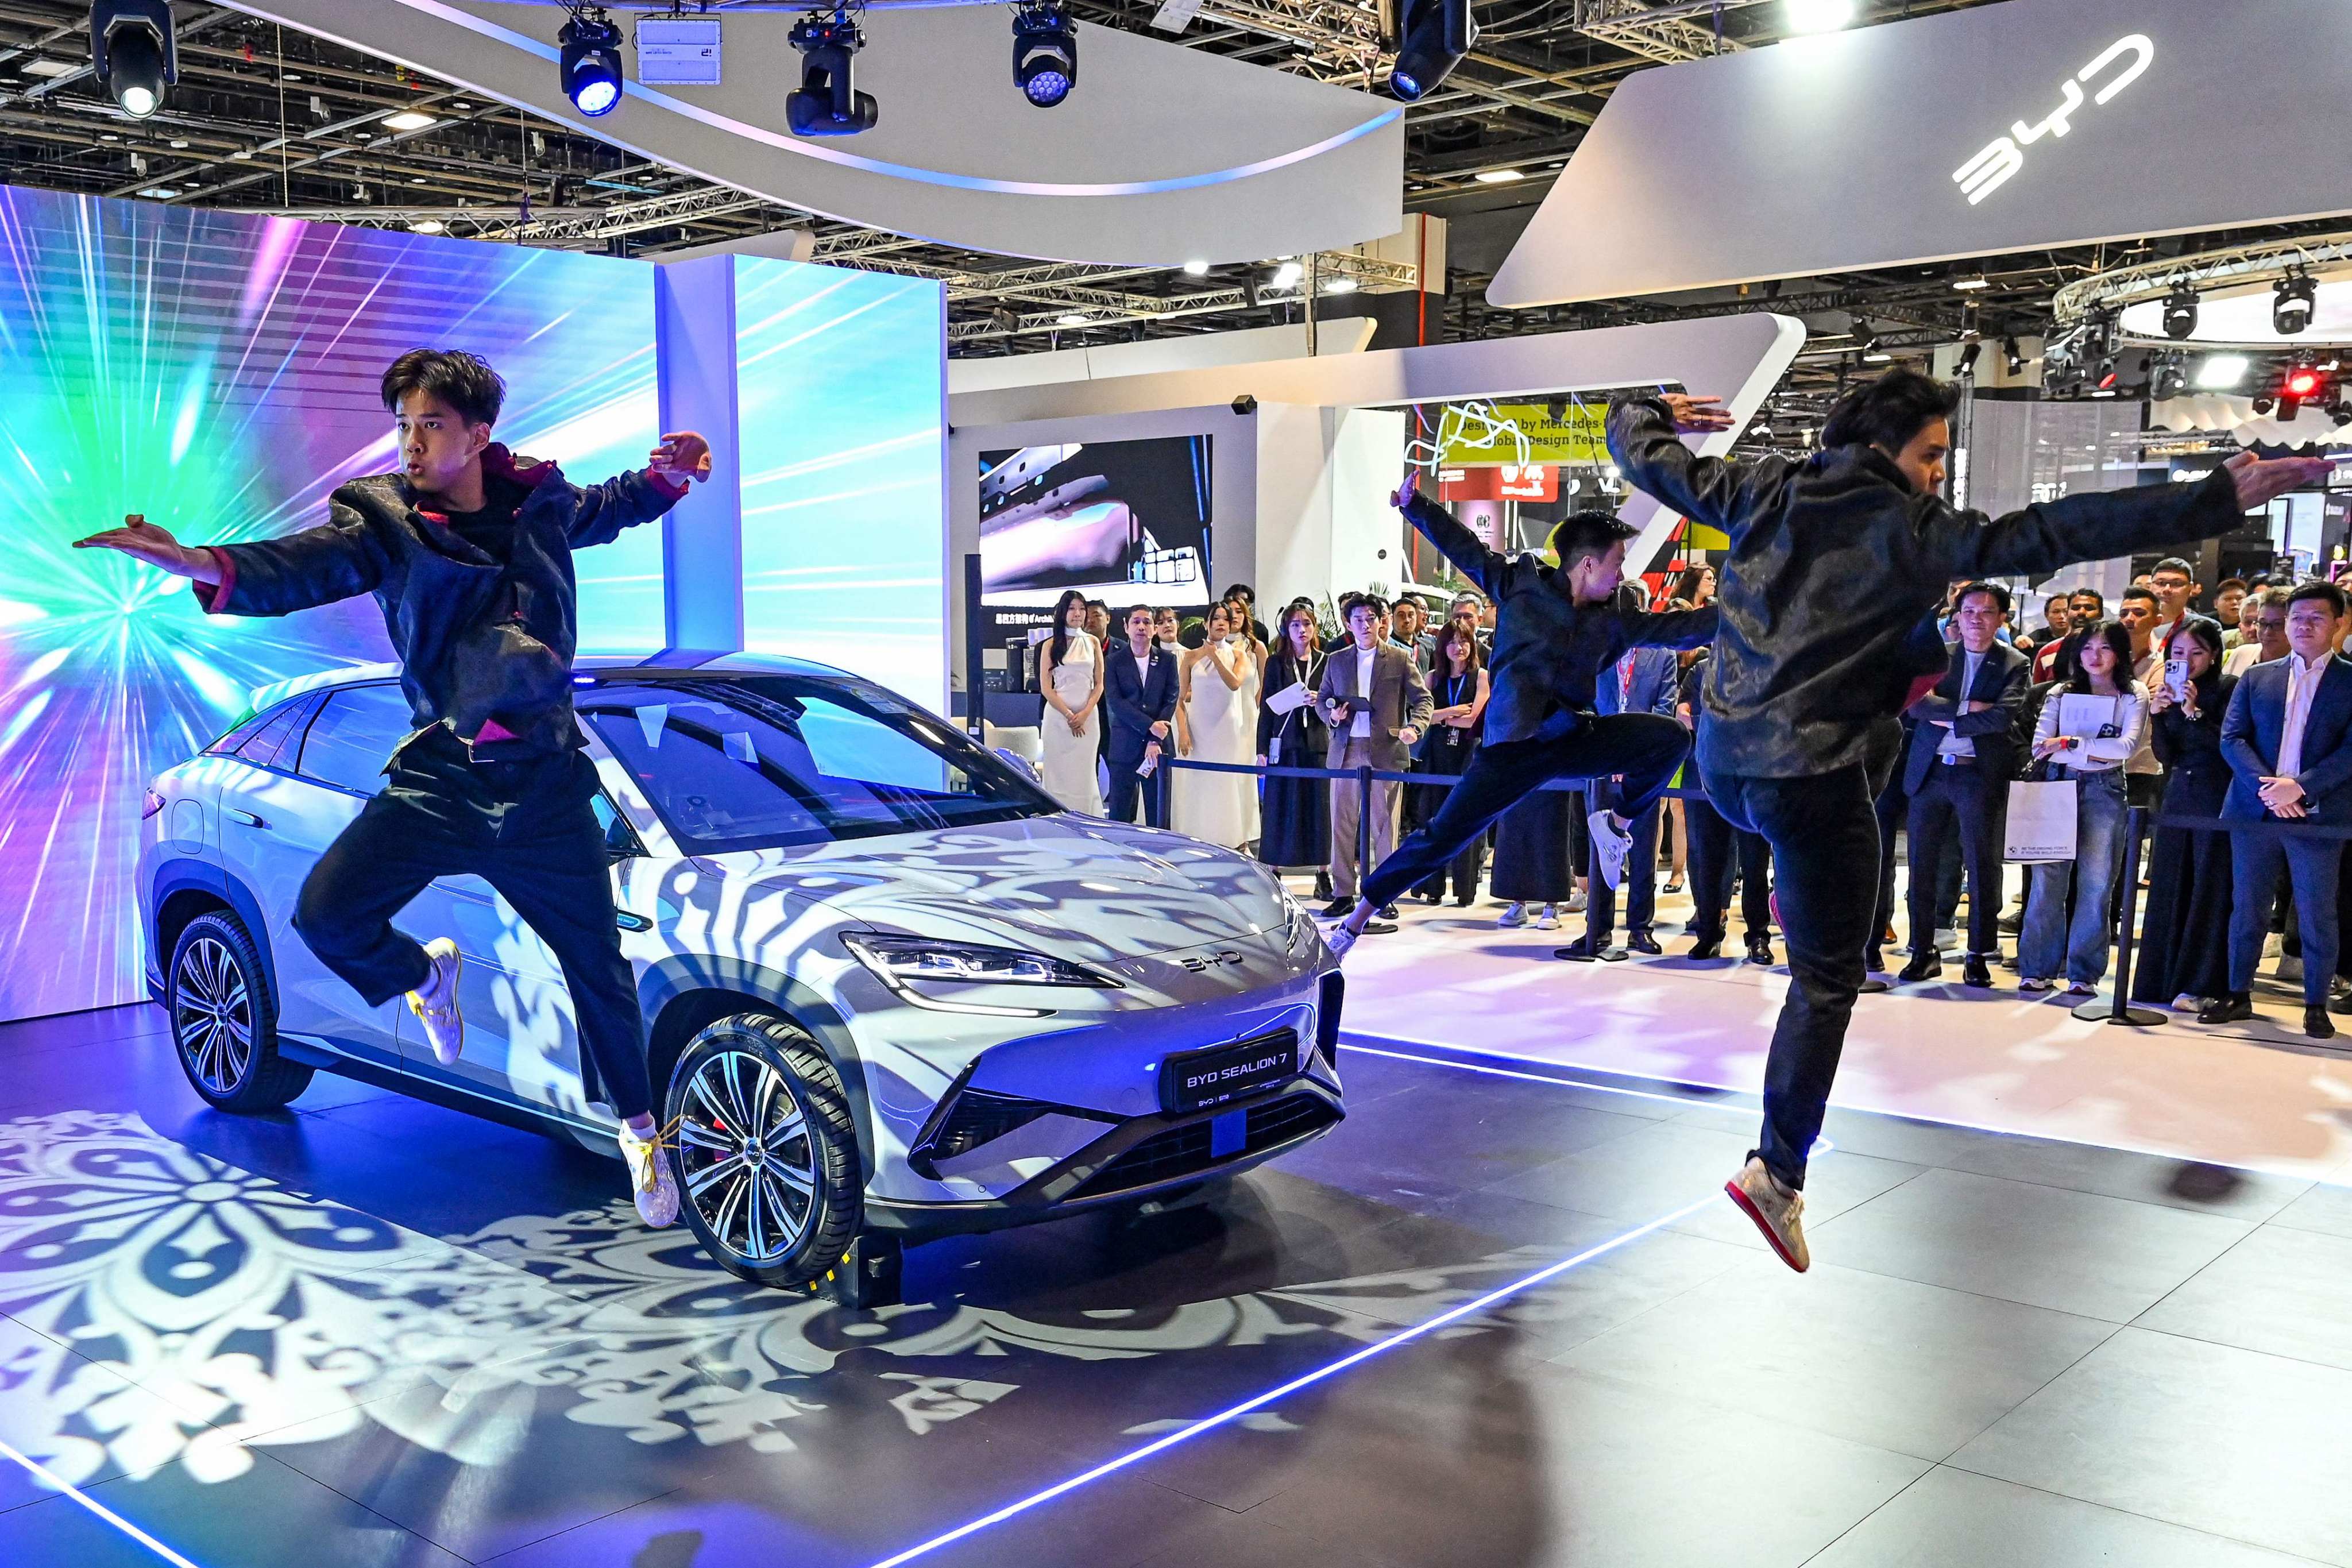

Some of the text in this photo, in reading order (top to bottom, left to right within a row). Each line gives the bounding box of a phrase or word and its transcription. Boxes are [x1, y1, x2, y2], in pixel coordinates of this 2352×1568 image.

[1951, 33, 2155, 206] BYD
[1521, 419, 1536, 432] by
[1528, 434, 1570, 448] Design
[1573, 435, 1606, 445] Team
[1180, 951, 1243, 974] BYD
[1187, 1052, 1288, 1088] BYD SEALION 7
[1198, 1098, 1214, 1107] BYD
